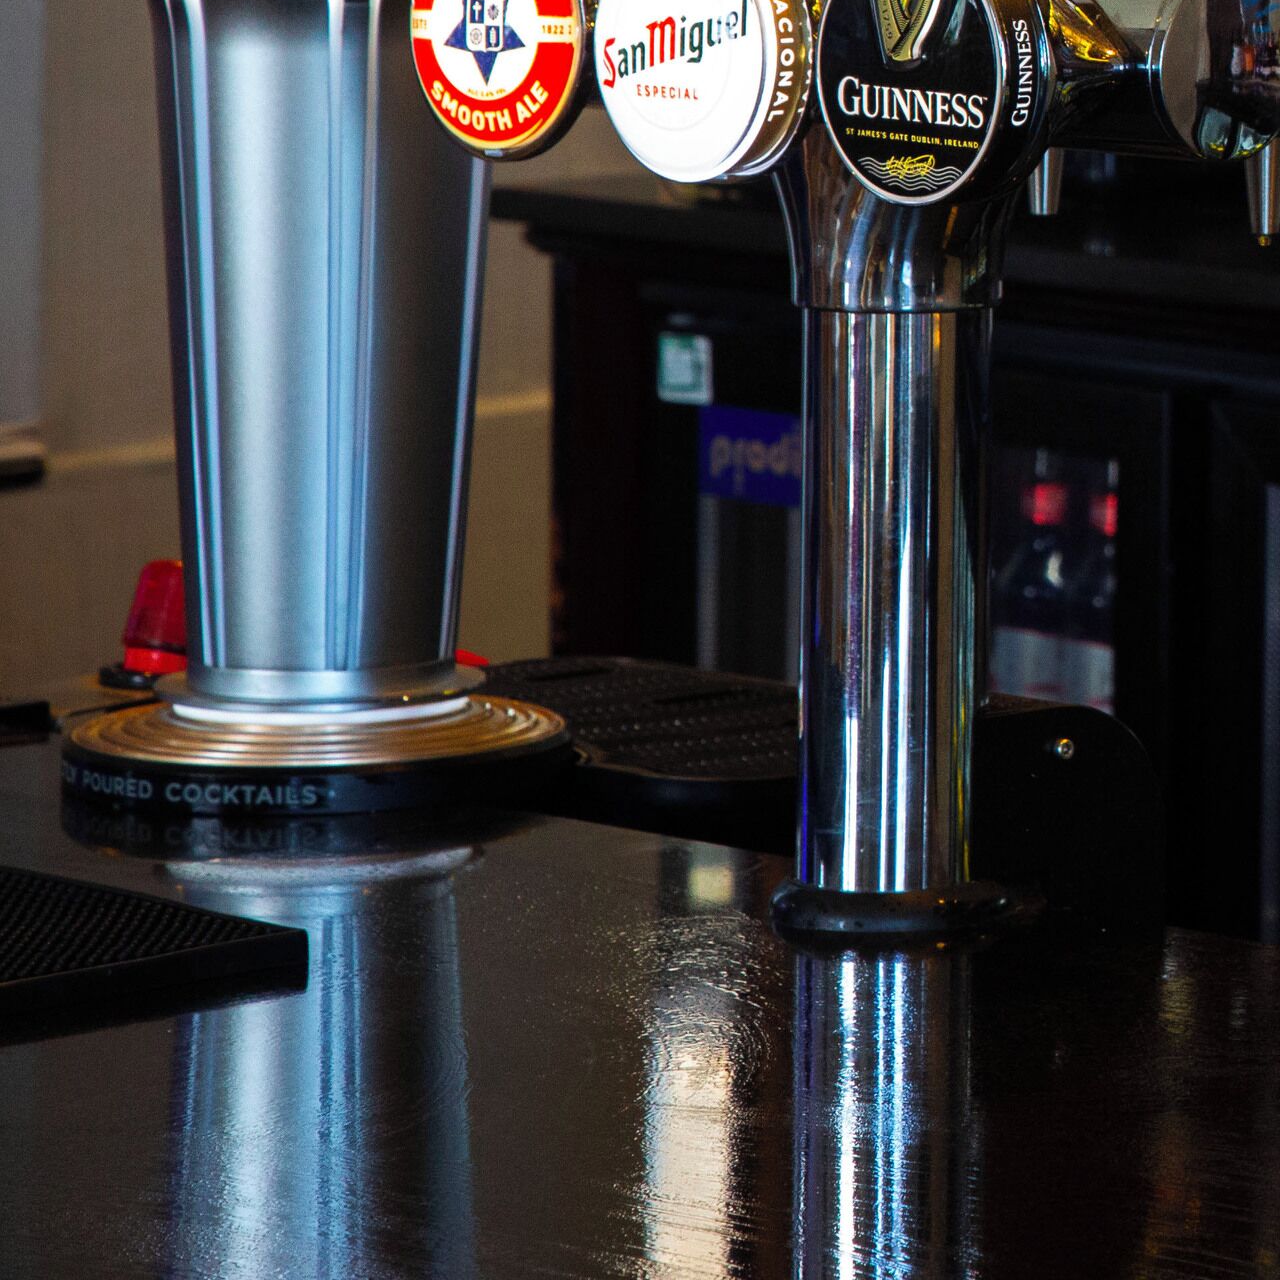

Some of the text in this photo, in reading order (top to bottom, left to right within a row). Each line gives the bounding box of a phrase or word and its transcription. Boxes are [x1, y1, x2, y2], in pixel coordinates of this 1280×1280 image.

[636, 83, 699, 101] ESPECIAL
[1010, 18, 1034, 127] GUINNESS
[429, 79, 551, 133] SMOOTH ALE
[837, 75, 985, 129] GUINNESS
[889, 132, 909, 142] GATE
[81, 768, 153, 800] POURED
[163, 781, 319, 807] COCKTAILS
